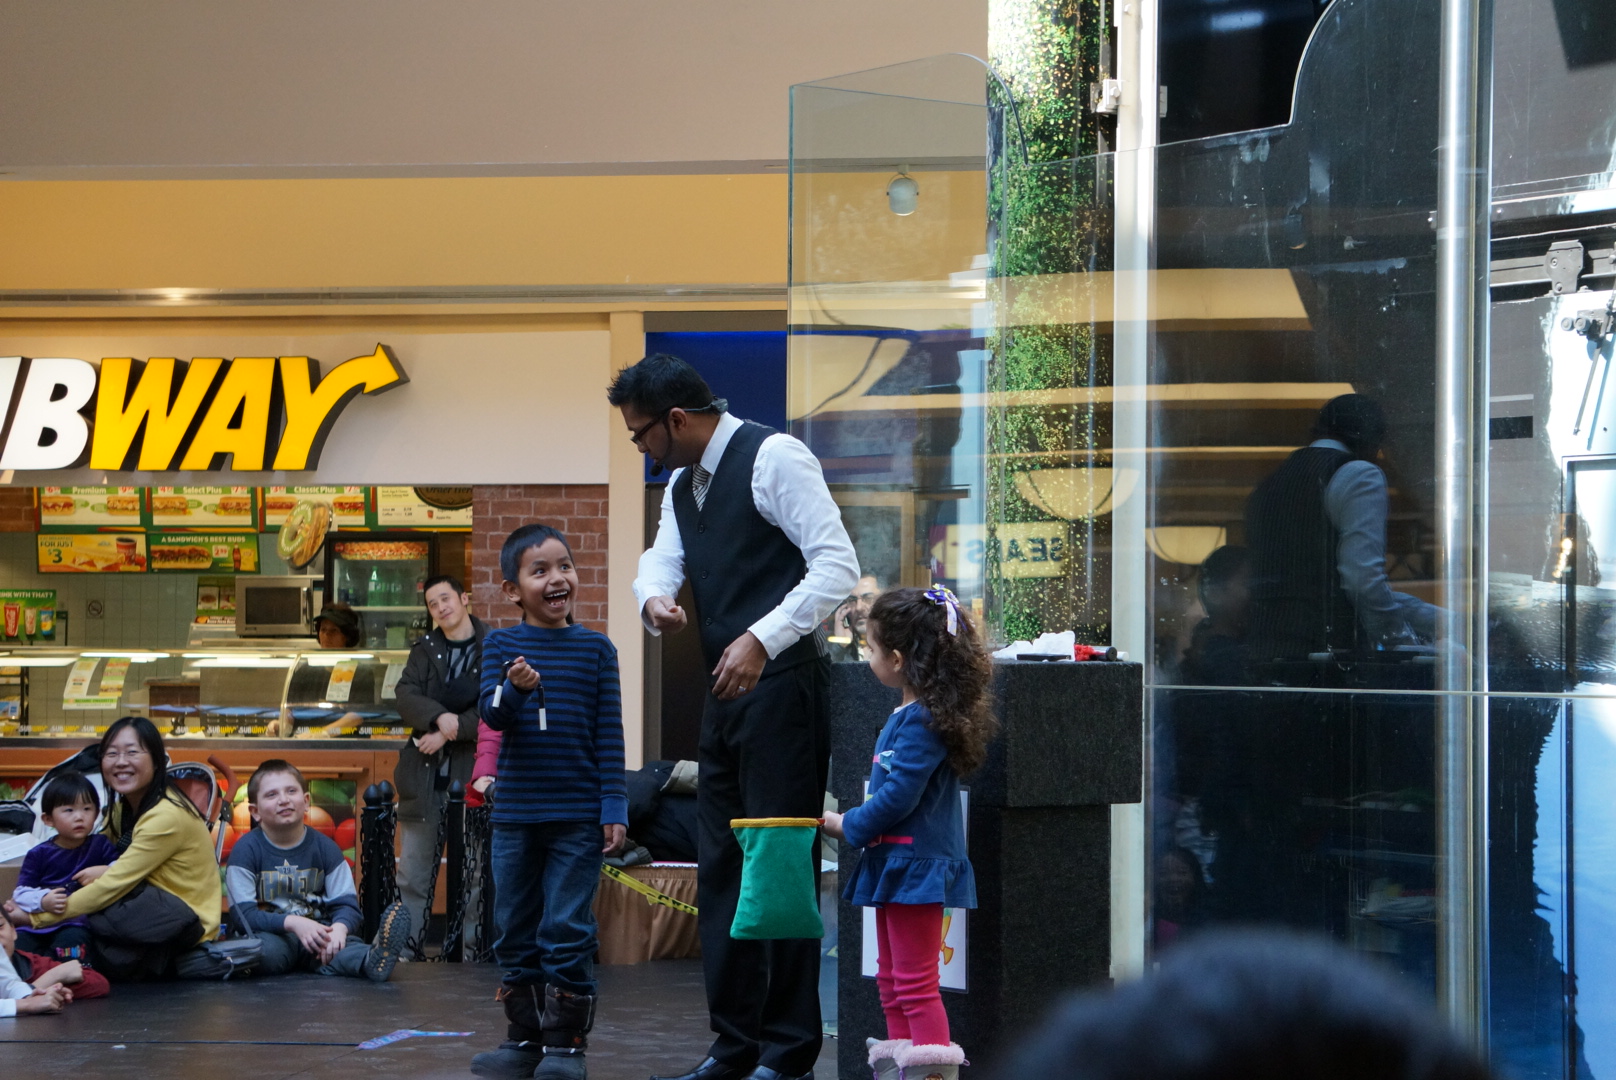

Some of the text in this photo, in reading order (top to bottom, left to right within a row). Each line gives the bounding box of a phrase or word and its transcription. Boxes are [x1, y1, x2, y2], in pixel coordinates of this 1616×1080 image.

[0, 343, 403, 471] BWAY
[72, 486, 107, 494] Premium
[183, 486, 205, 494] Select
[206, 486, 222, 494] Plus
[294, 486, 319, 494] Classic
[320, 486, 336, 494] Plus
[56, 540, 73, 548] JUST
[48, 548, 63, 564] $3
[207, 725, 237, 733] SUBWAY
[359, 726, 389, 735] SUBWAY
